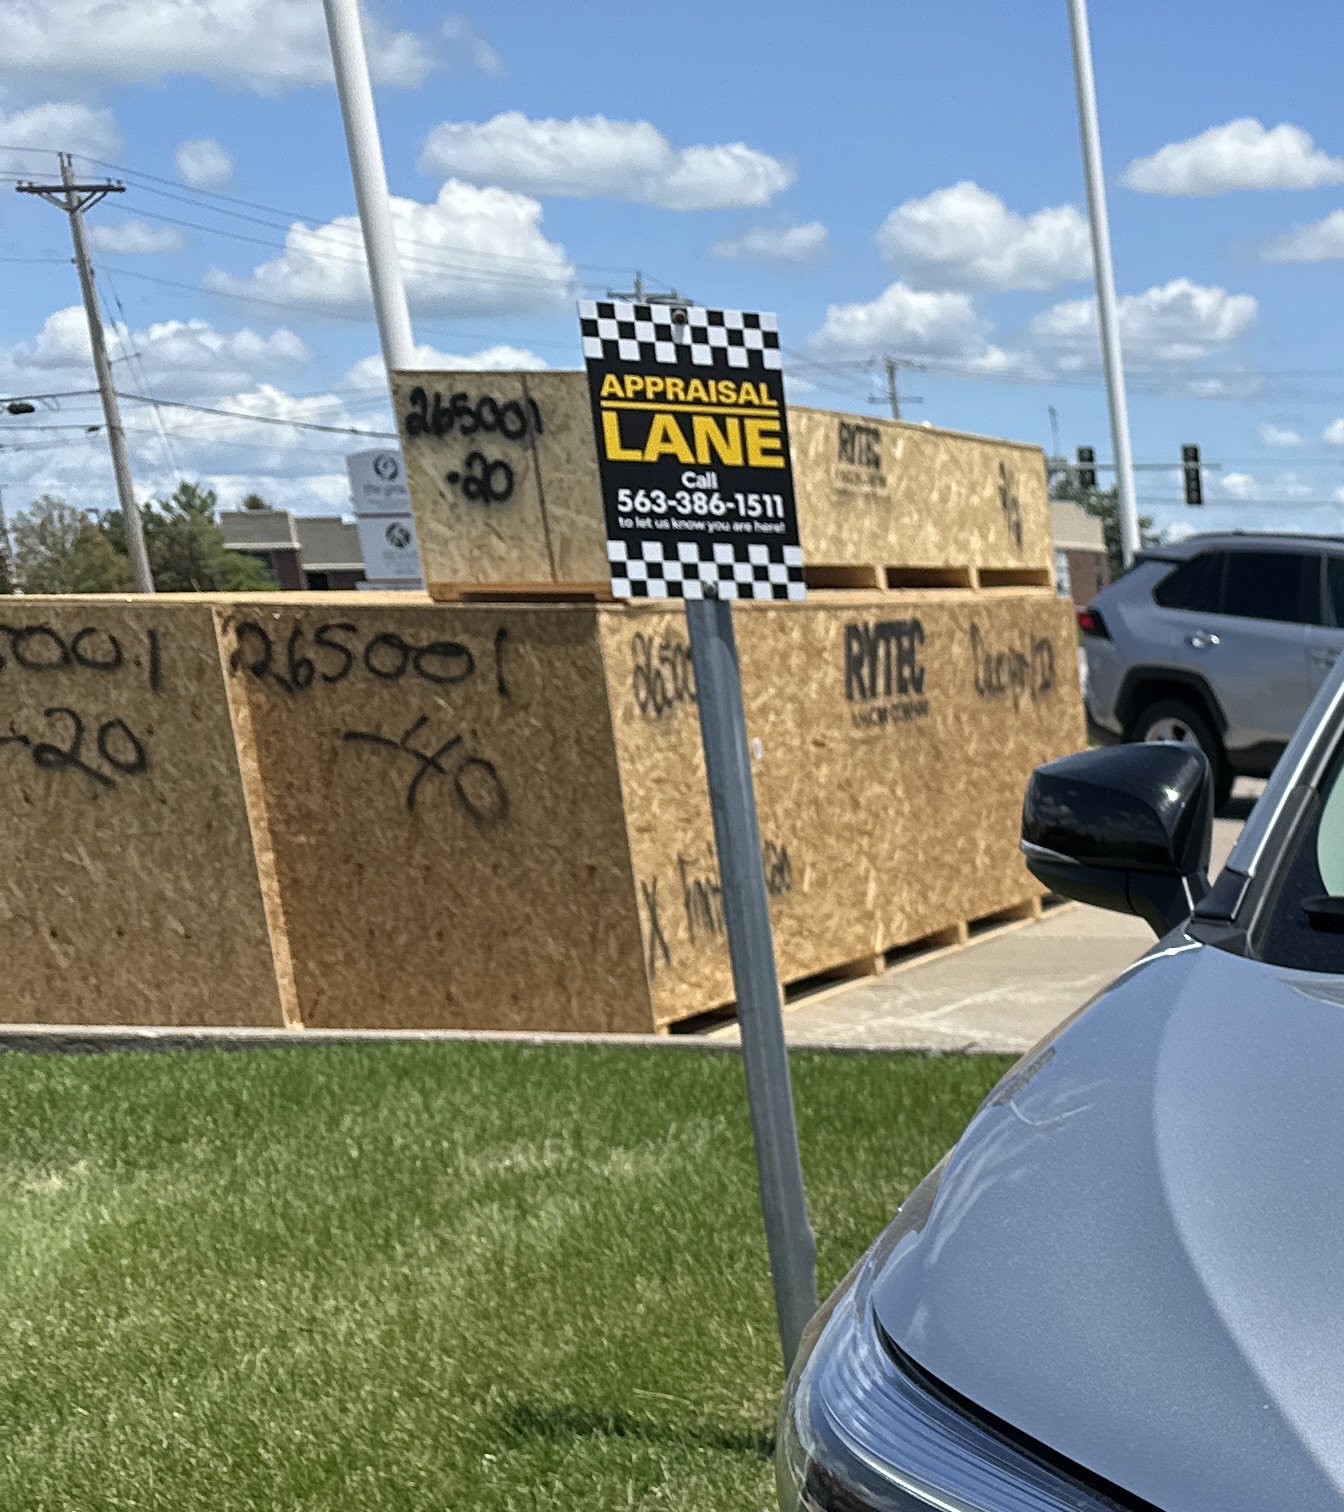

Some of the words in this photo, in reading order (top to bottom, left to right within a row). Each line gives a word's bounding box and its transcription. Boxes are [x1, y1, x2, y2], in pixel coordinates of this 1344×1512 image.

[601, 373, 778, 407] APPRAISAL
[602, 410, 786, 468] LANE
[681, 471, 718, 490] Call
[617, 489, 785, 519] 563-386-1511
[618, 516, 634, 529] to
[635, 516, 653, 529] let
[654, 518, 671, 530] us
[671, 517, 706, 531] know
[706, 520, 731, 533] you
[732, 520, 753, 532] are
[844, 616, 926, 701] RYTEC
